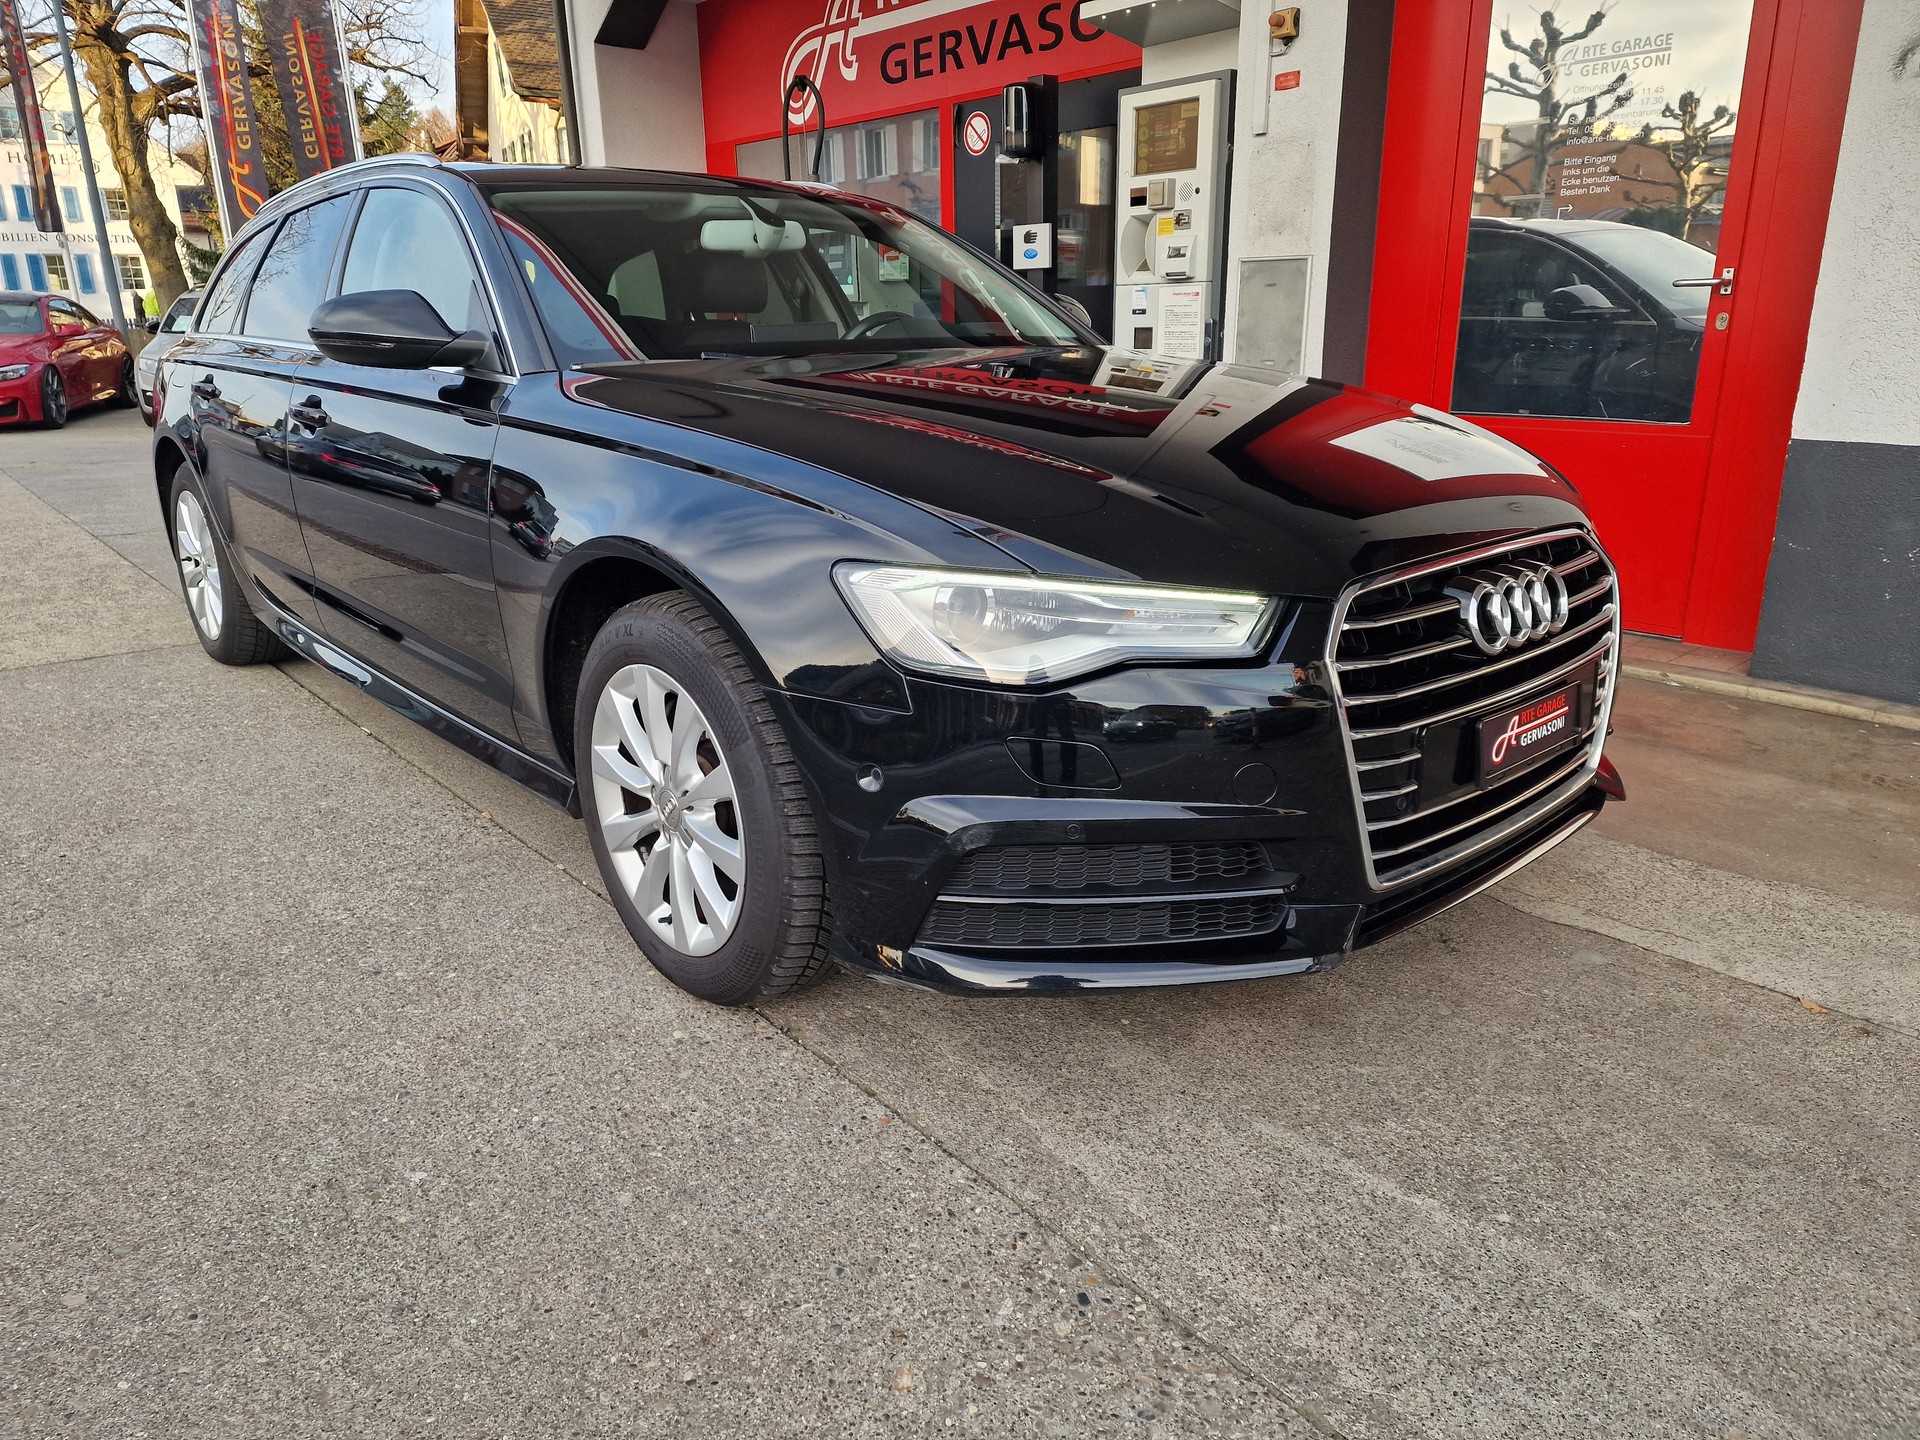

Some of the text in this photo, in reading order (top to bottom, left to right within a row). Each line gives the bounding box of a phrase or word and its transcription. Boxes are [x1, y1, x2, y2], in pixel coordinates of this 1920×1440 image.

[1611, 32, 1674, 54] GARAGE
[1580, 52, 1672, 77] GERVASONI
[220, 14, 252, 151] GERVASONI
[1610, 100, 1632, 111] 3.30
[1566, 130, 1645, 146] info@arte-tug.ch
[1568, 126, 1581, 136] Tel.
[7, 151, 71, 165] HME
[1563, 154, 1617, 167] Bitte Eingang
[1562, 164, 1610, 176] links um die
[1561, 174, 1622, 187] Ecke benutzen.
[1560, 184, 1611, 197] Besten Dank
[622, 623, 634, 637] XL
[1536, 694, 1567, 718] GARAGE
[1520, 715, 1566, 746] GERVASONI
